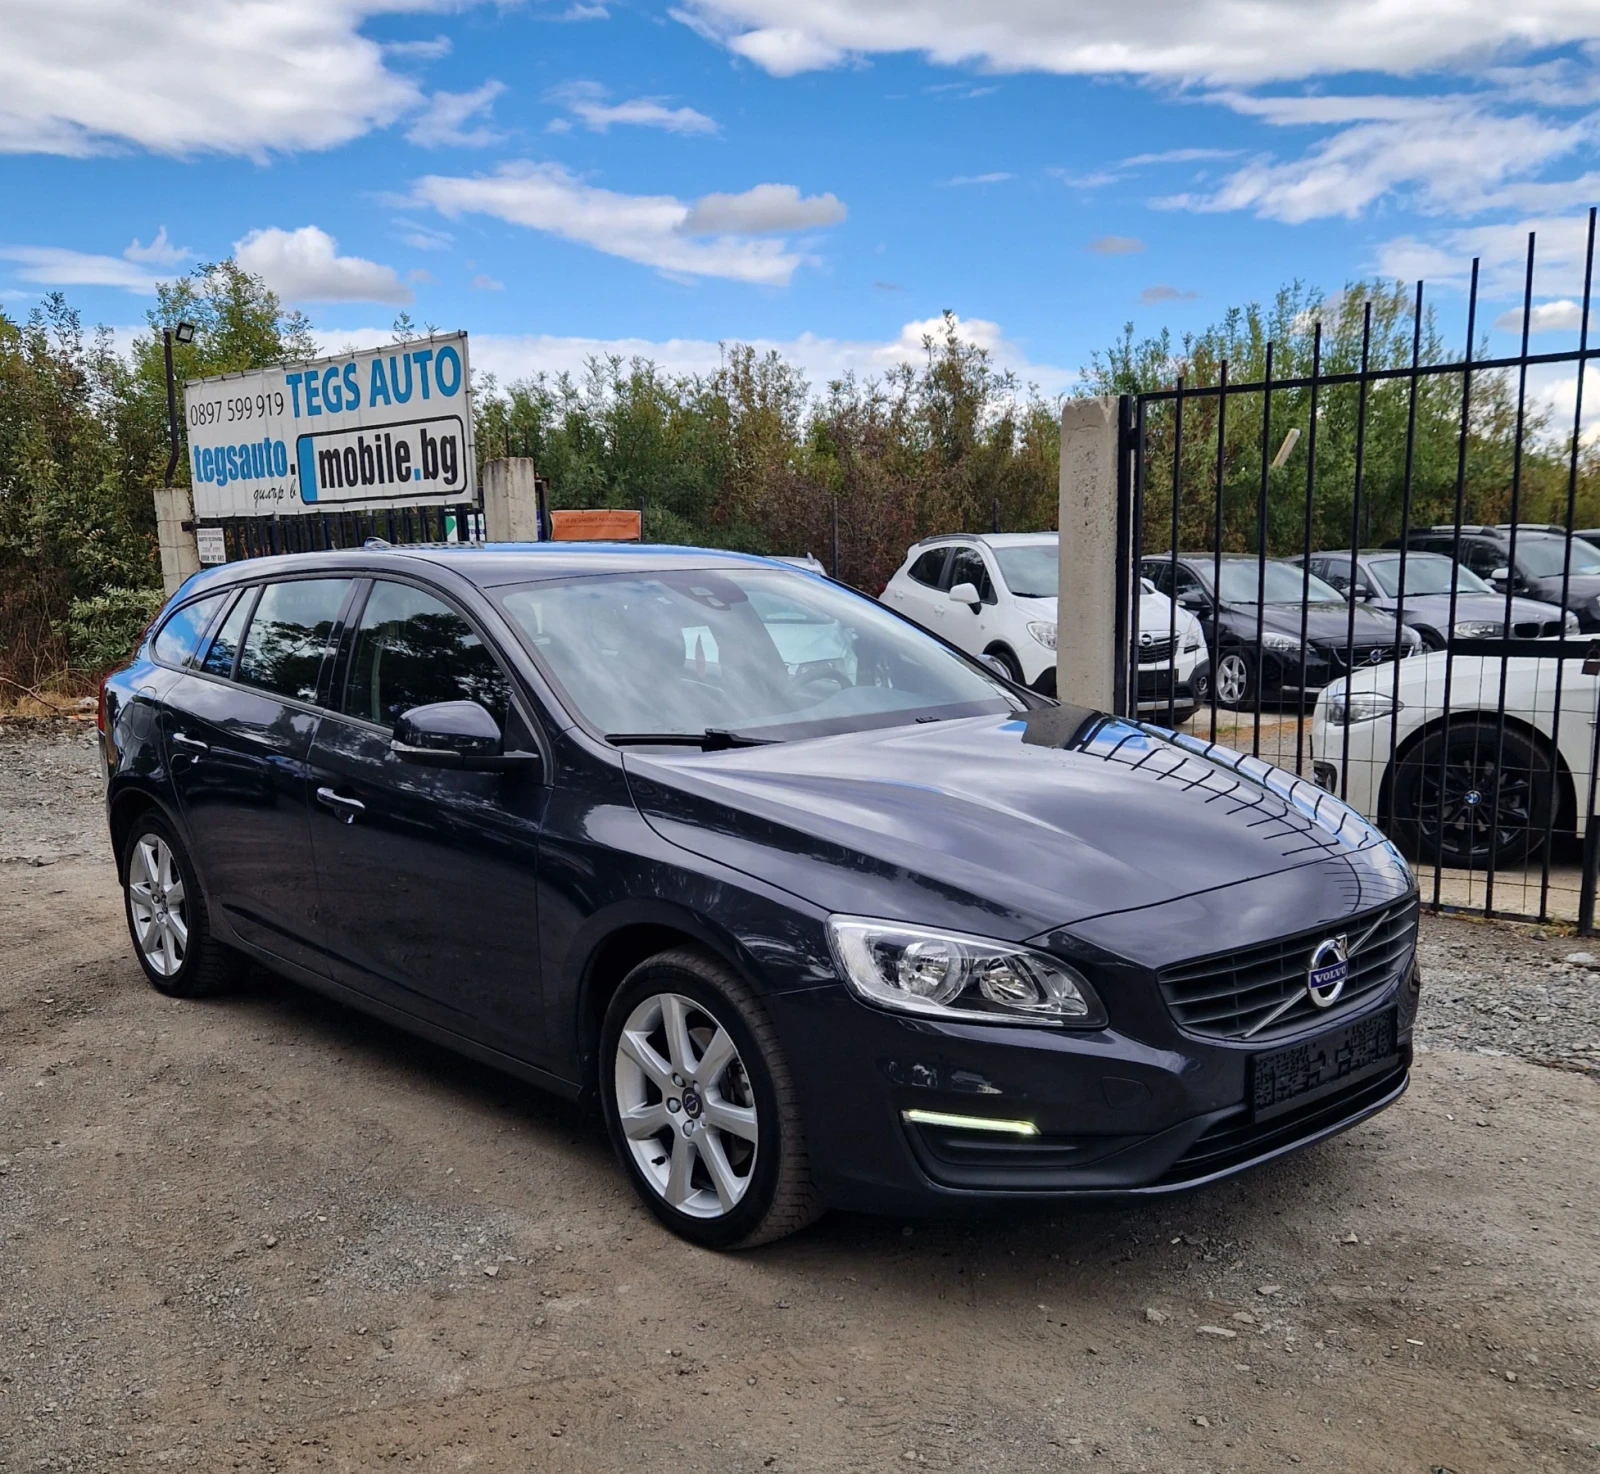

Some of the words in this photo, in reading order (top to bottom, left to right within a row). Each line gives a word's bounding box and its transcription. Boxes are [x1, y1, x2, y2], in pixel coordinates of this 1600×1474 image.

[286, 362, 361, 418] TEGS
[369, 345, 461, 408] AUTO
[190, 401, 223, 426] 0897
[227, 396, 252, 422] 599
[256, 391, 284, 418] 919
[318, 428, 459, 489] mobile.bg
[1313, 965, 1347, 983] VOLVO
